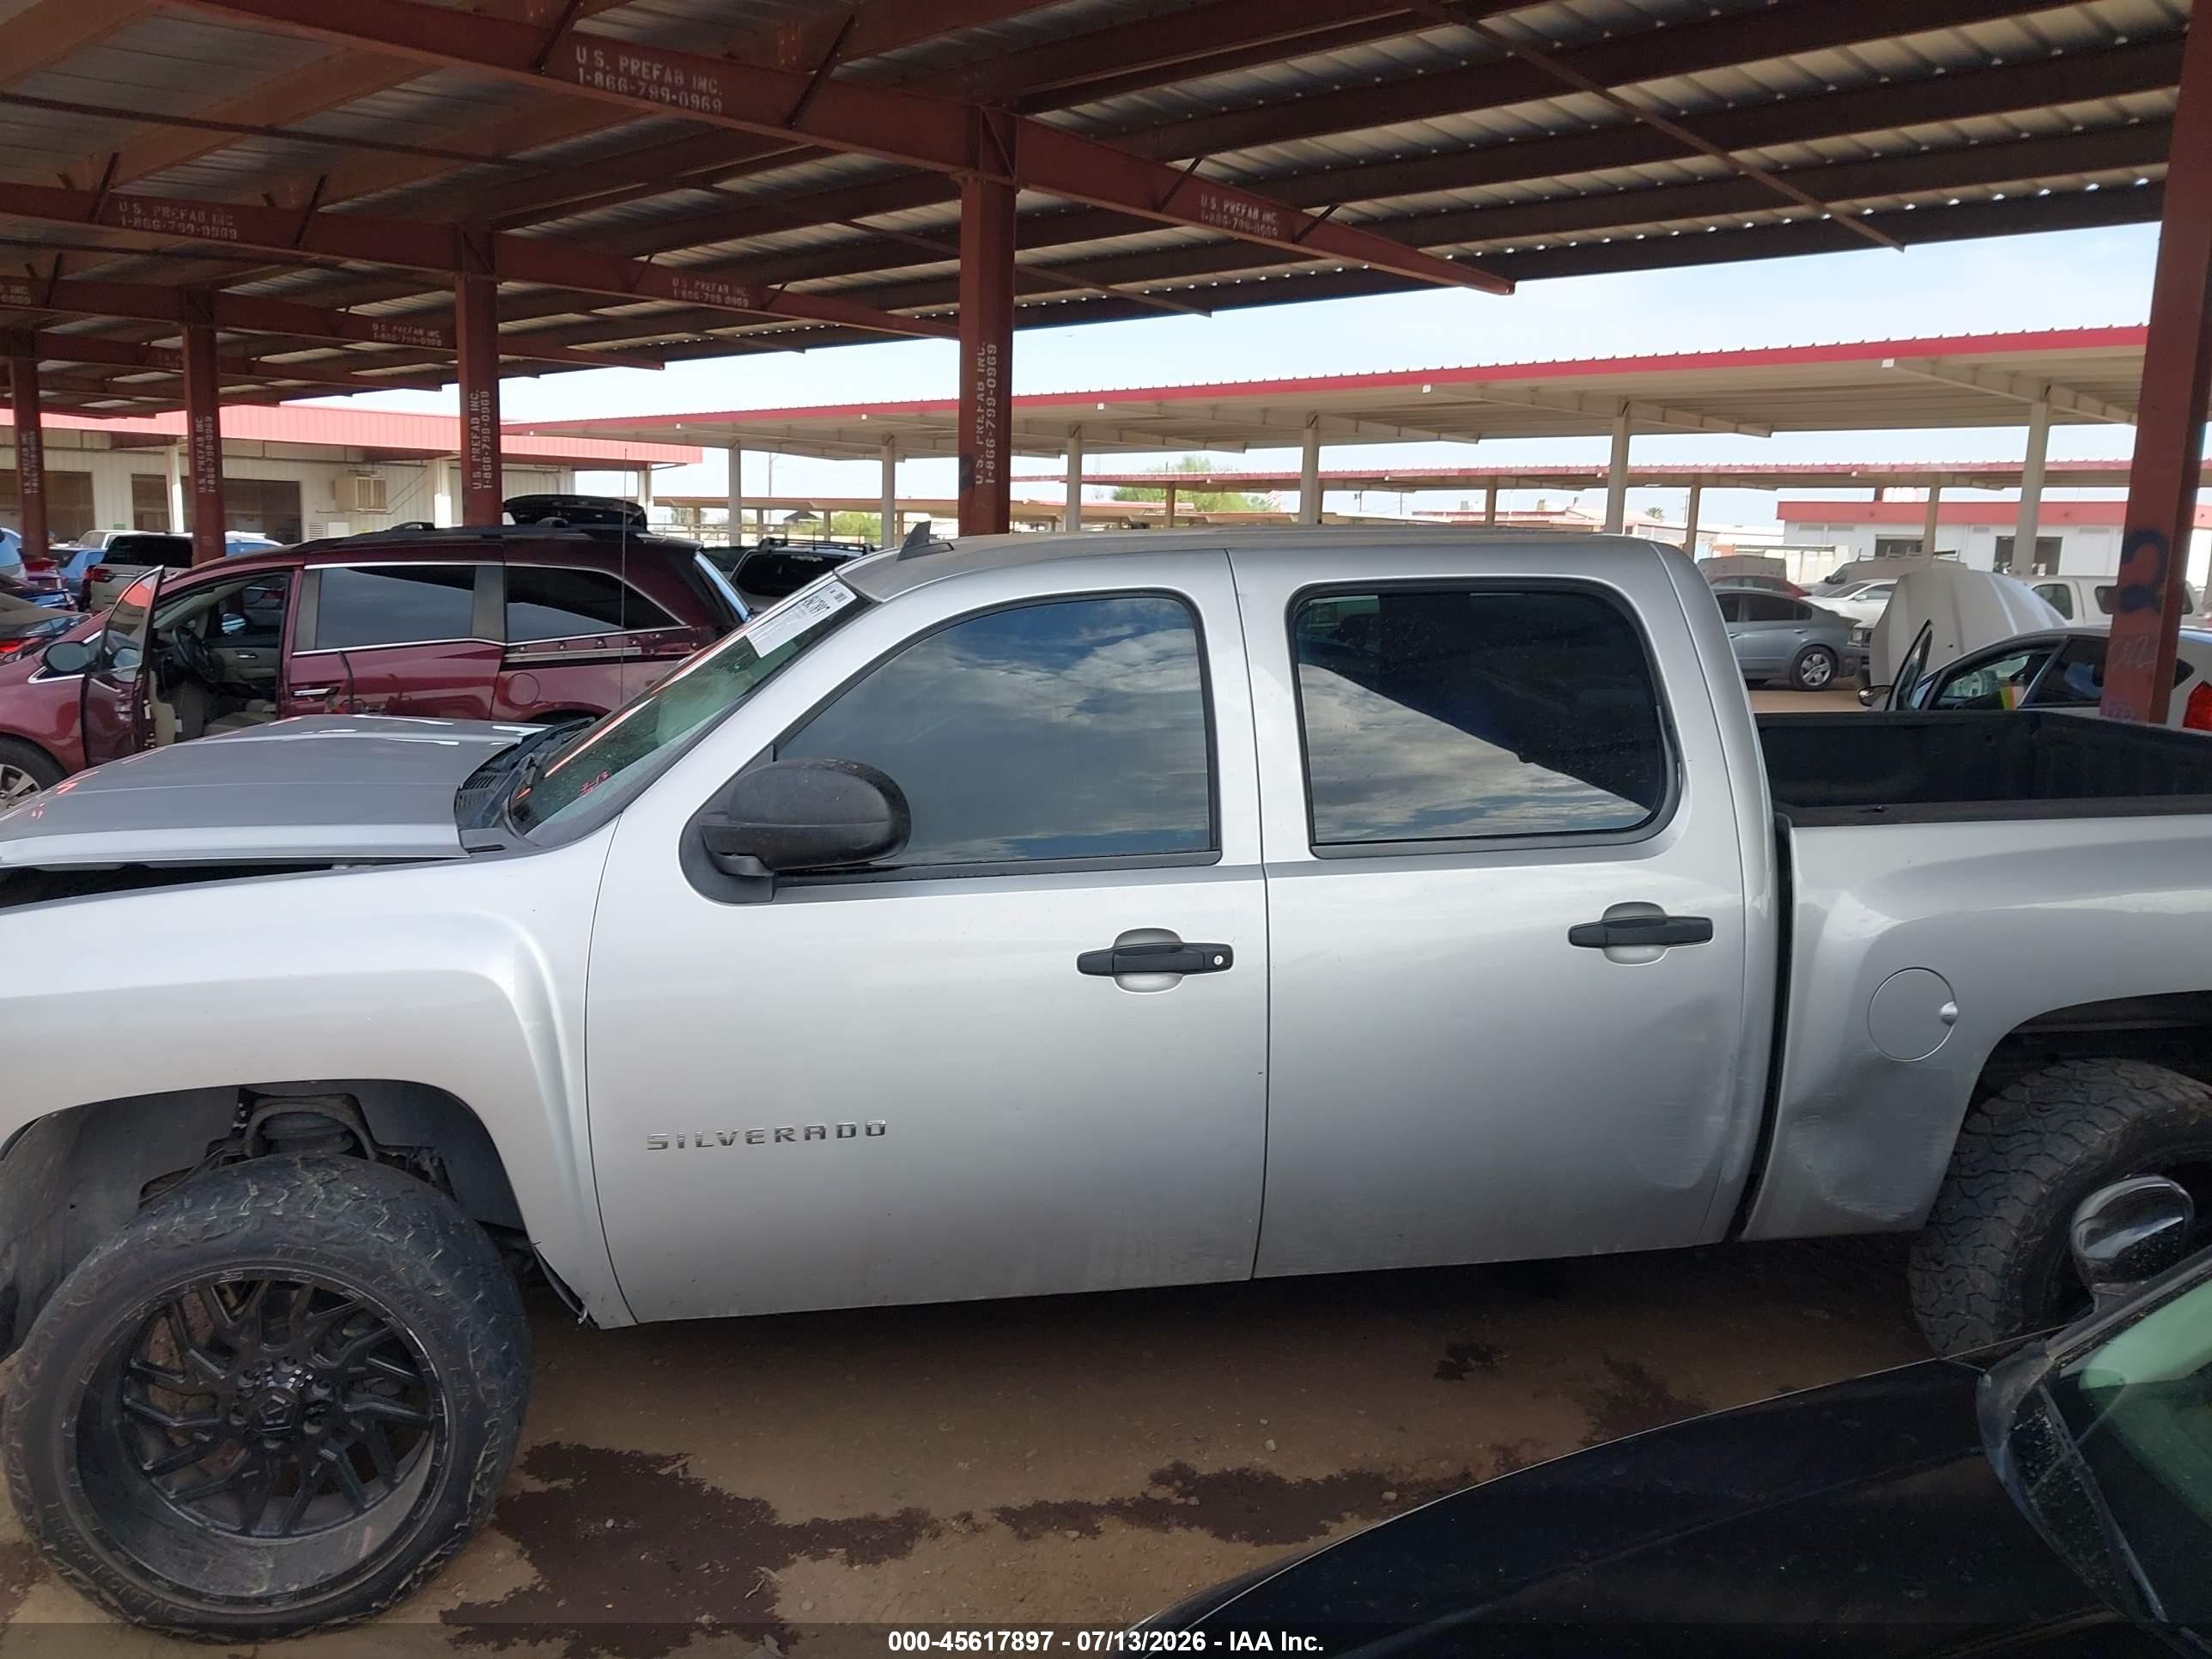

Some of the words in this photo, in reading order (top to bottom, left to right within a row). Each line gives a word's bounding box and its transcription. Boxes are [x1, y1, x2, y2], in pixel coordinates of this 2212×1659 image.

[577, 66, 723, 114] 1-866-799-0969
[619, 55, 684, 85] PREFAB
[692, 75, 723, 96] INC.
[153, 205, 206, 223] PREFAB
[1223, 199, 1260, 220] PREFAB
[694, 280, 729, 295] PREFAB
[976, 341, 987, 372] INC.
[470, 389, 480, 411] INC.
[975, 381, 985, 445] PREFAB
[986, 343, 998, 483] 1-866-799-0969
[471, 416, 481, 462] PREFAB
[480, 391, 493, 489] 1-866-799-0969
[471, 467, 482, 489] U.S.
[975, 453, 984, 484] U.S.
[647, 1120, 887, 1151] SILVERADO
